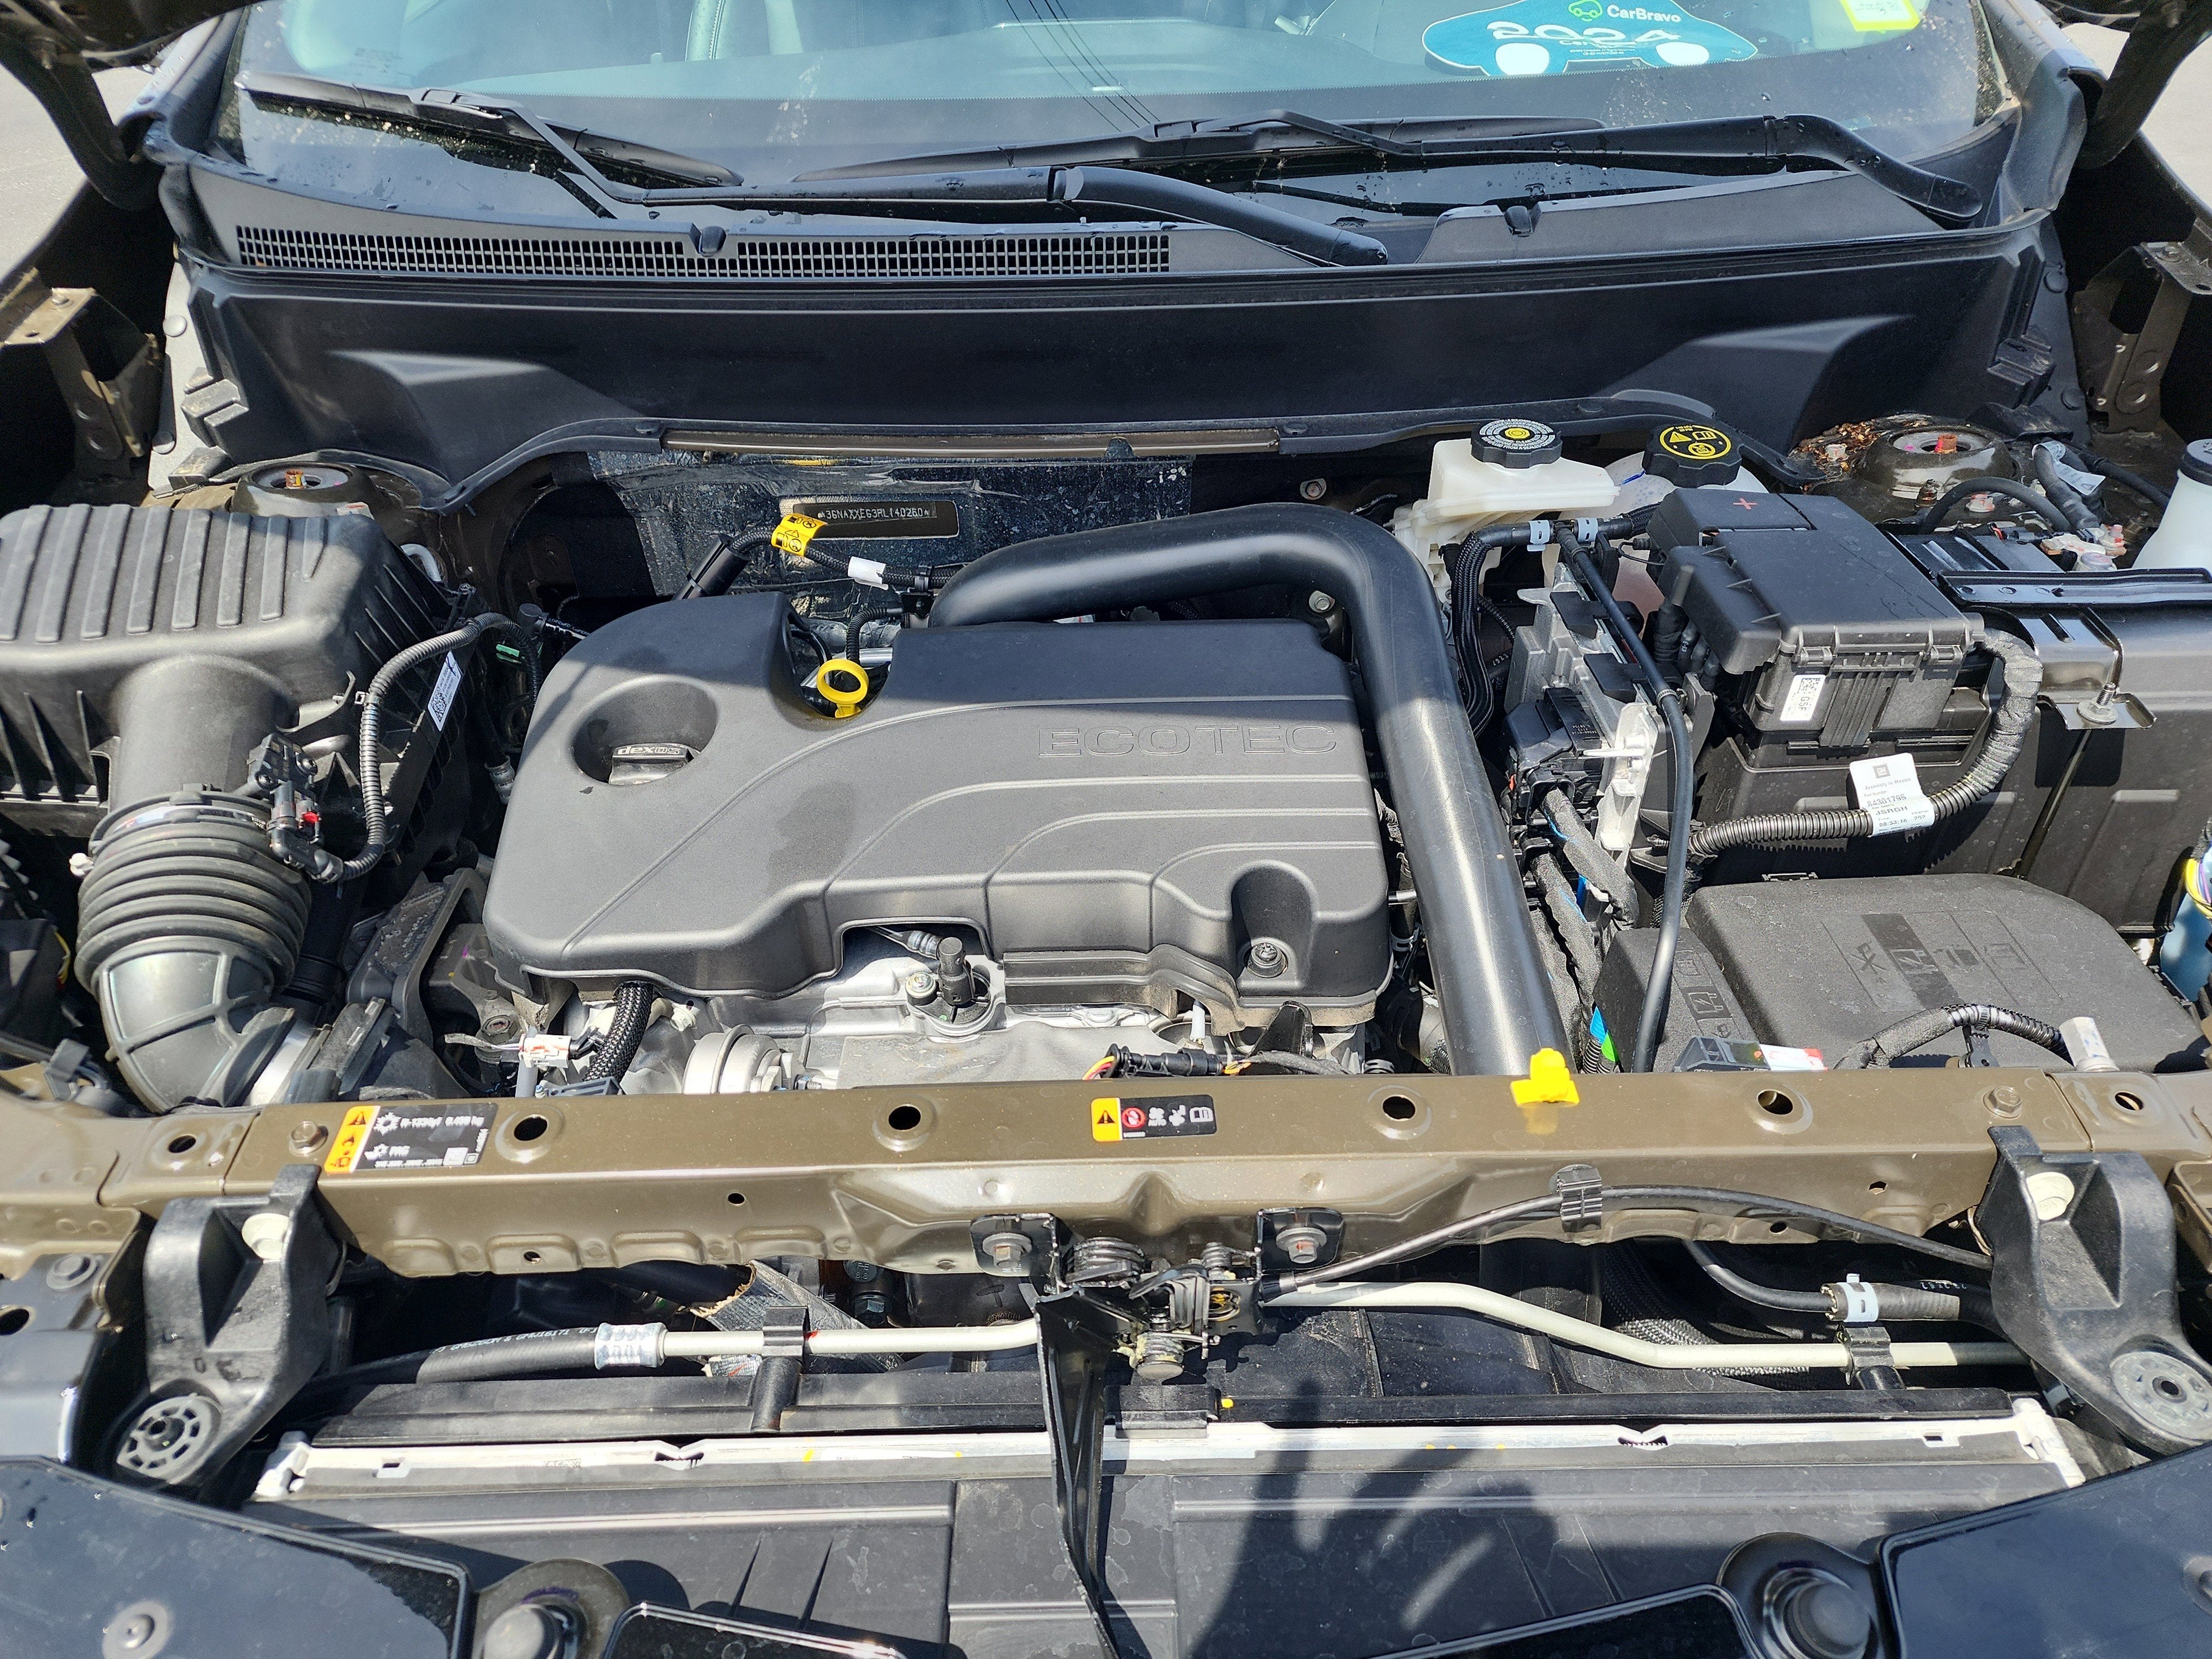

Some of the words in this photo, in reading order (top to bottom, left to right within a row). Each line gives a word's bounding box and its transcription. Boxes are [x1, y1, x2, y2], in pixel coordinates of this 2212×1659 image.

[1607, 4, 1682, 23] CarBravo
[1486, 21, 1682, 45] 2024
[1798, 696, 1811, 711] G5F
[1039, 723, 1337, 757] ECOTEC
[617, 746, 681, 755] dexos
[1865, 781, 1887, 790] Assembly
[1866, 794, 1907, 807] 84301795
[1875, 806, 1908, 816] JSRGH
[1879, 818, 1908, 827] 08:53:16
